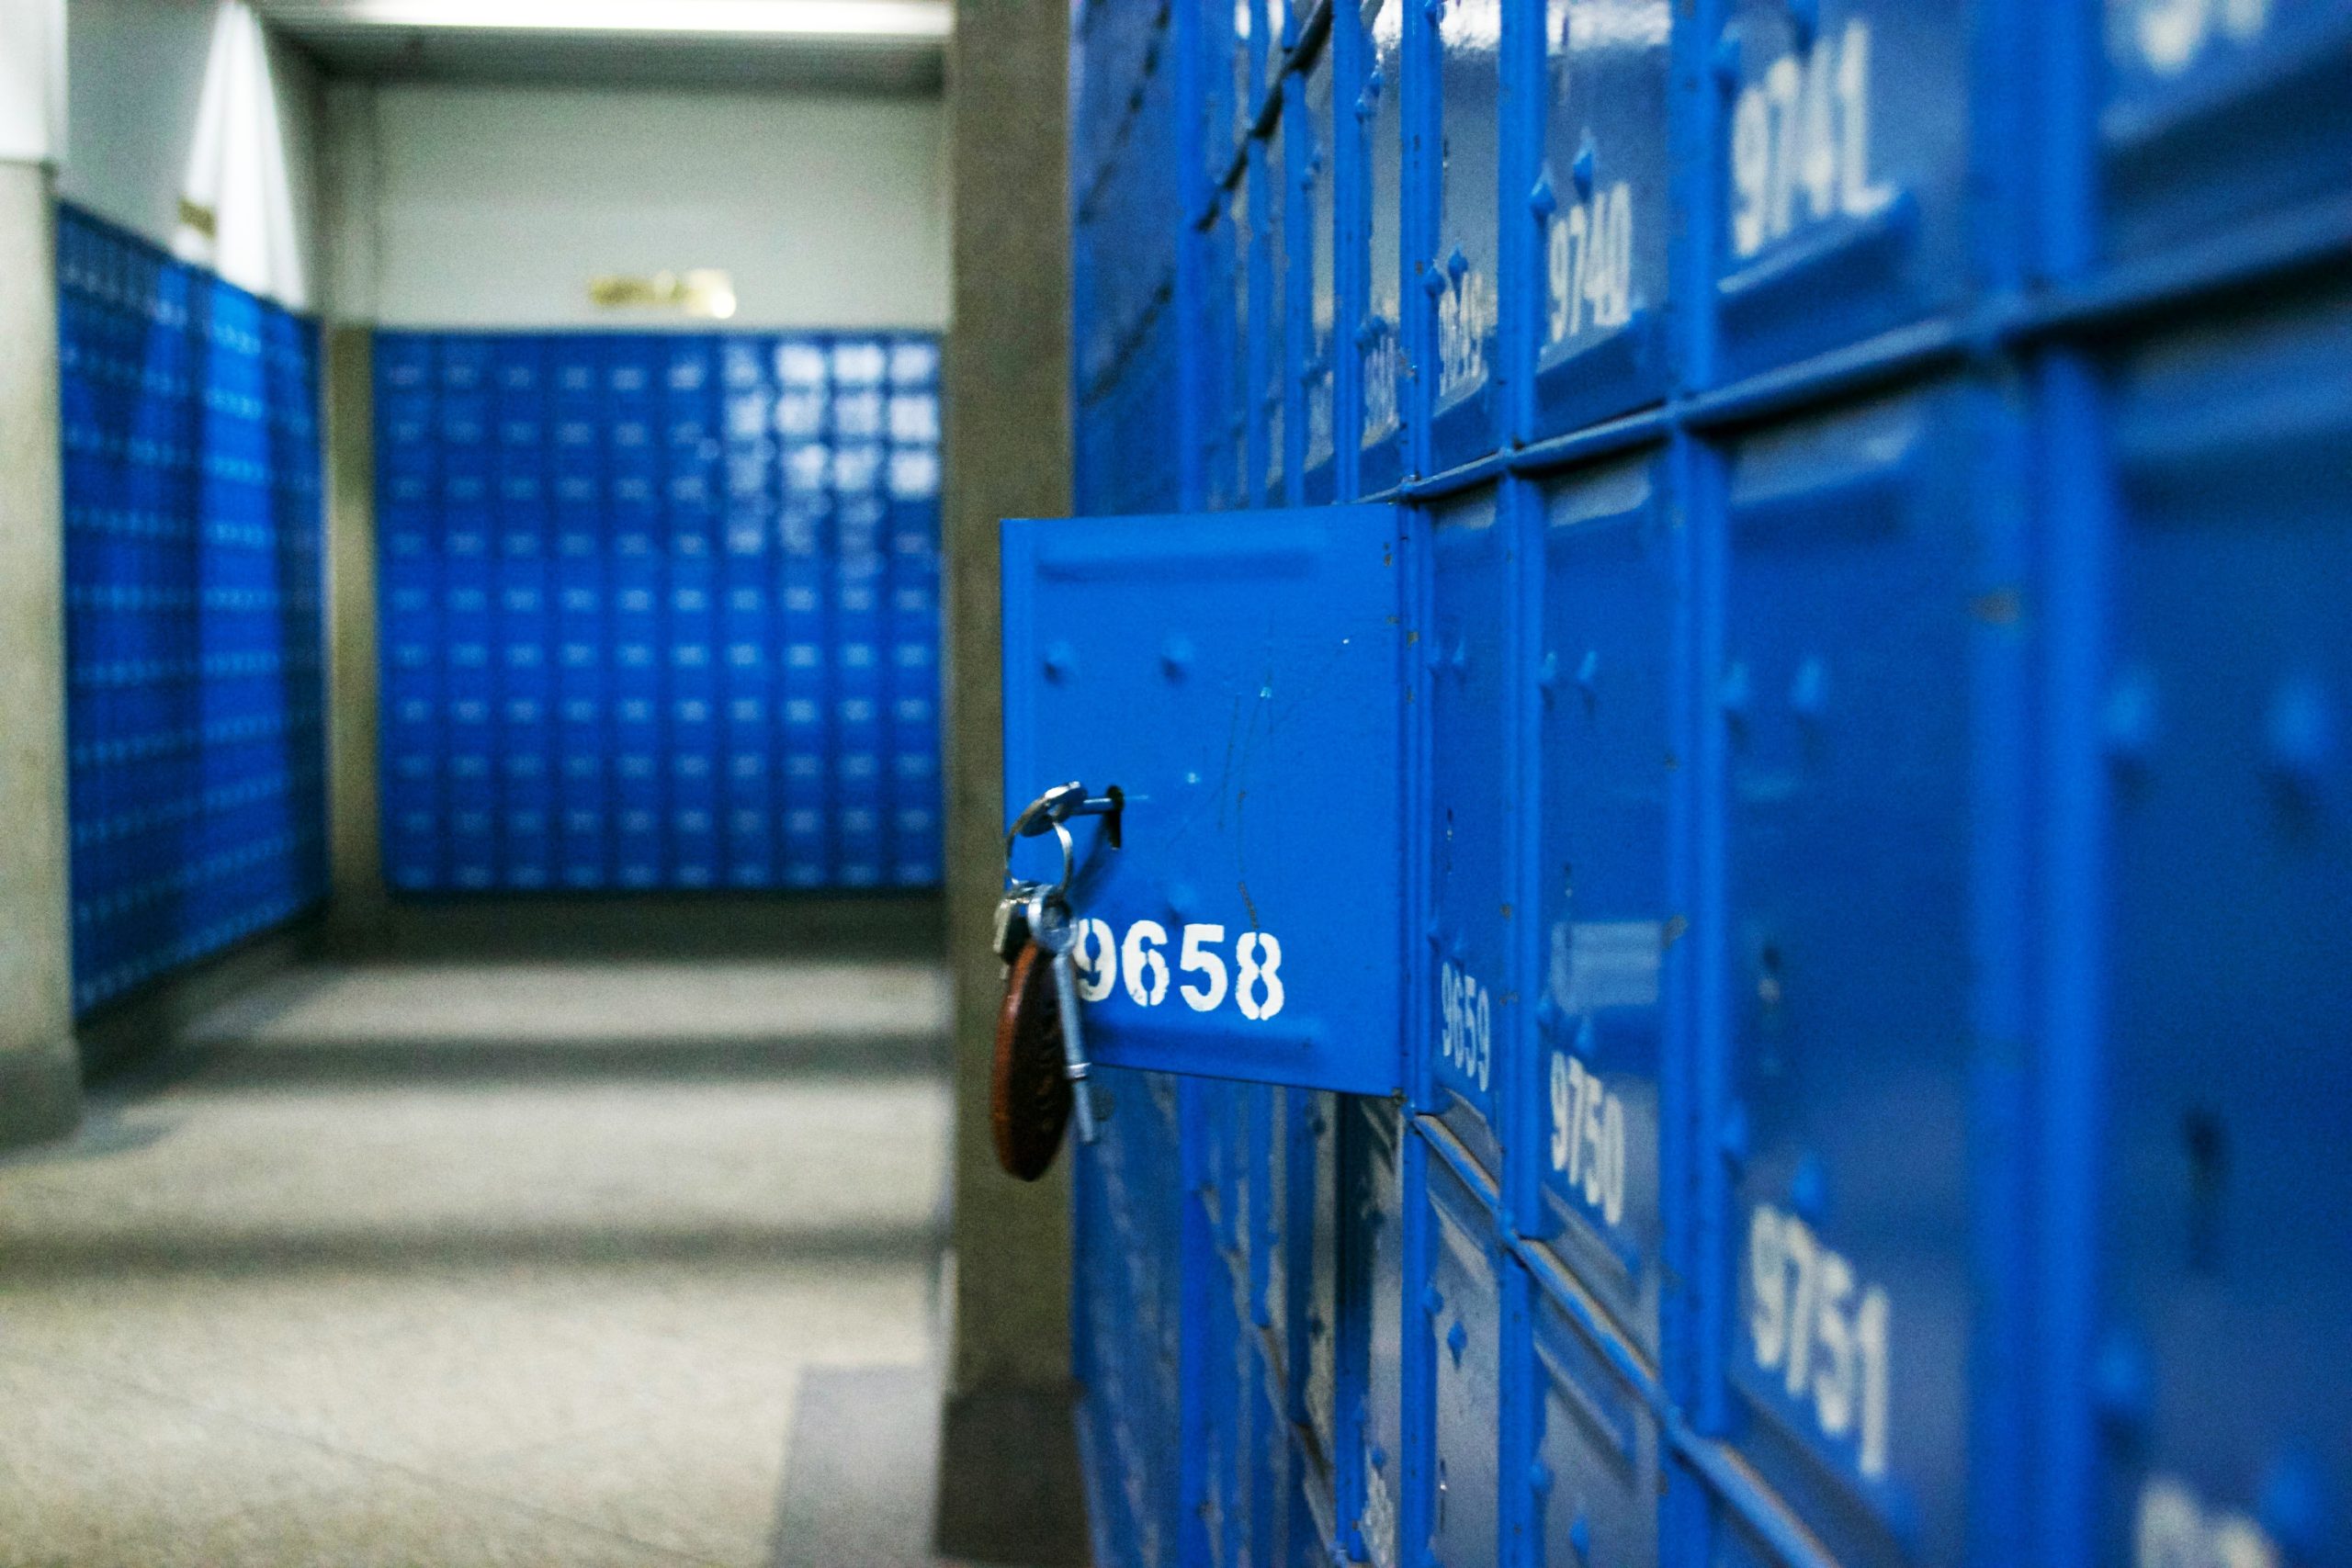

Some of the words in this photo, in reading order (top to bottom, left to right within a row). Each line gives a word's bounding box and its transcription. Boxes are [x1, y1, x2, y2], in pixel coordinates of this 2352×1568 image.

[1073, 919, 1284, 1021] 9658
[1442, 962, 1490, 1092] 9659
[1551, 1051, 1624, 1226] 9750
[1752, 1204, 1890, 1480] 9751
